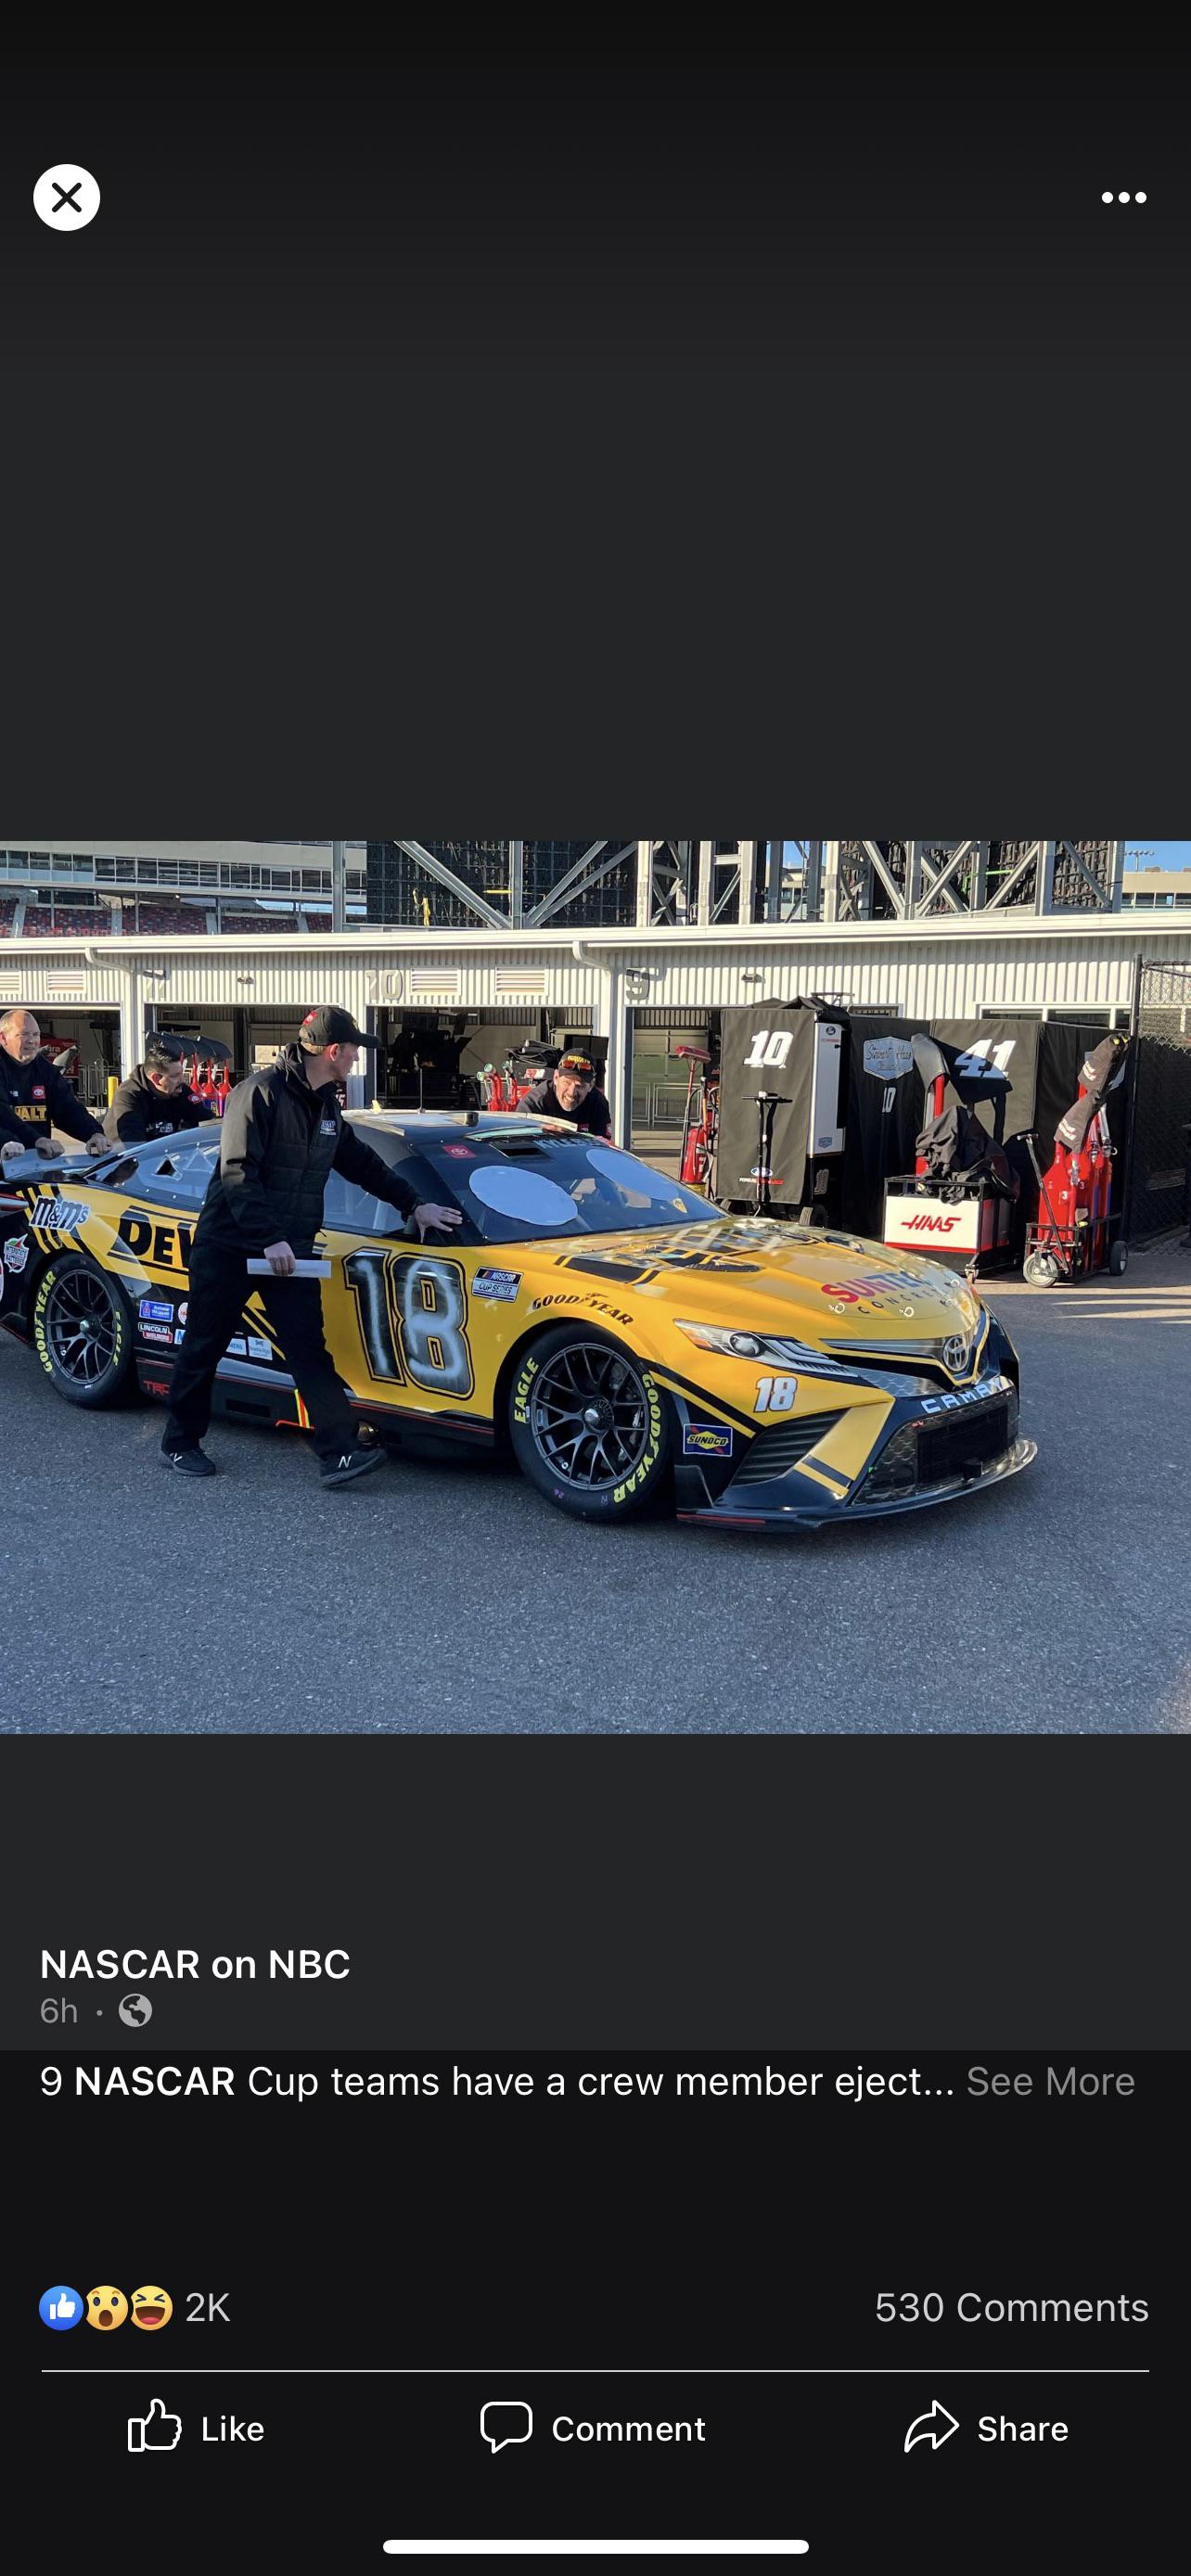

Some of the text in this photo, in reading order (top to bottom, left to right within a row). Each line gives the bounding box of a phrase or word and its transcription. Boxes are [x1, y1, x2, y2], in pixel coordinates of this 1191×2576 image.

[625, 968, 650, 1001] 9
[743, 1030, 793, 1068] 10
[954, 1039, 1017, 1079] 41
[881, 1087, 897, 1113] 10
[901, 1214, 962, 1233] HAAS
[479, 1282, 513, 1295] CUP SERIES
[490, 1271, 517, 1283] NASCAR
[342, 1246, 474, 1401] 18
[531, 1293, 634, 1325] GOODYEAR
[140, 1323, 168, 1333] LINCOLN
[514, 1357, 540, 1423] EAGLE
[753, 1376, 798, 1413] 18
[613, 1373, 661, 1503] GOODYEAR
[687, 1435, 728, 1447] SUNOCO
